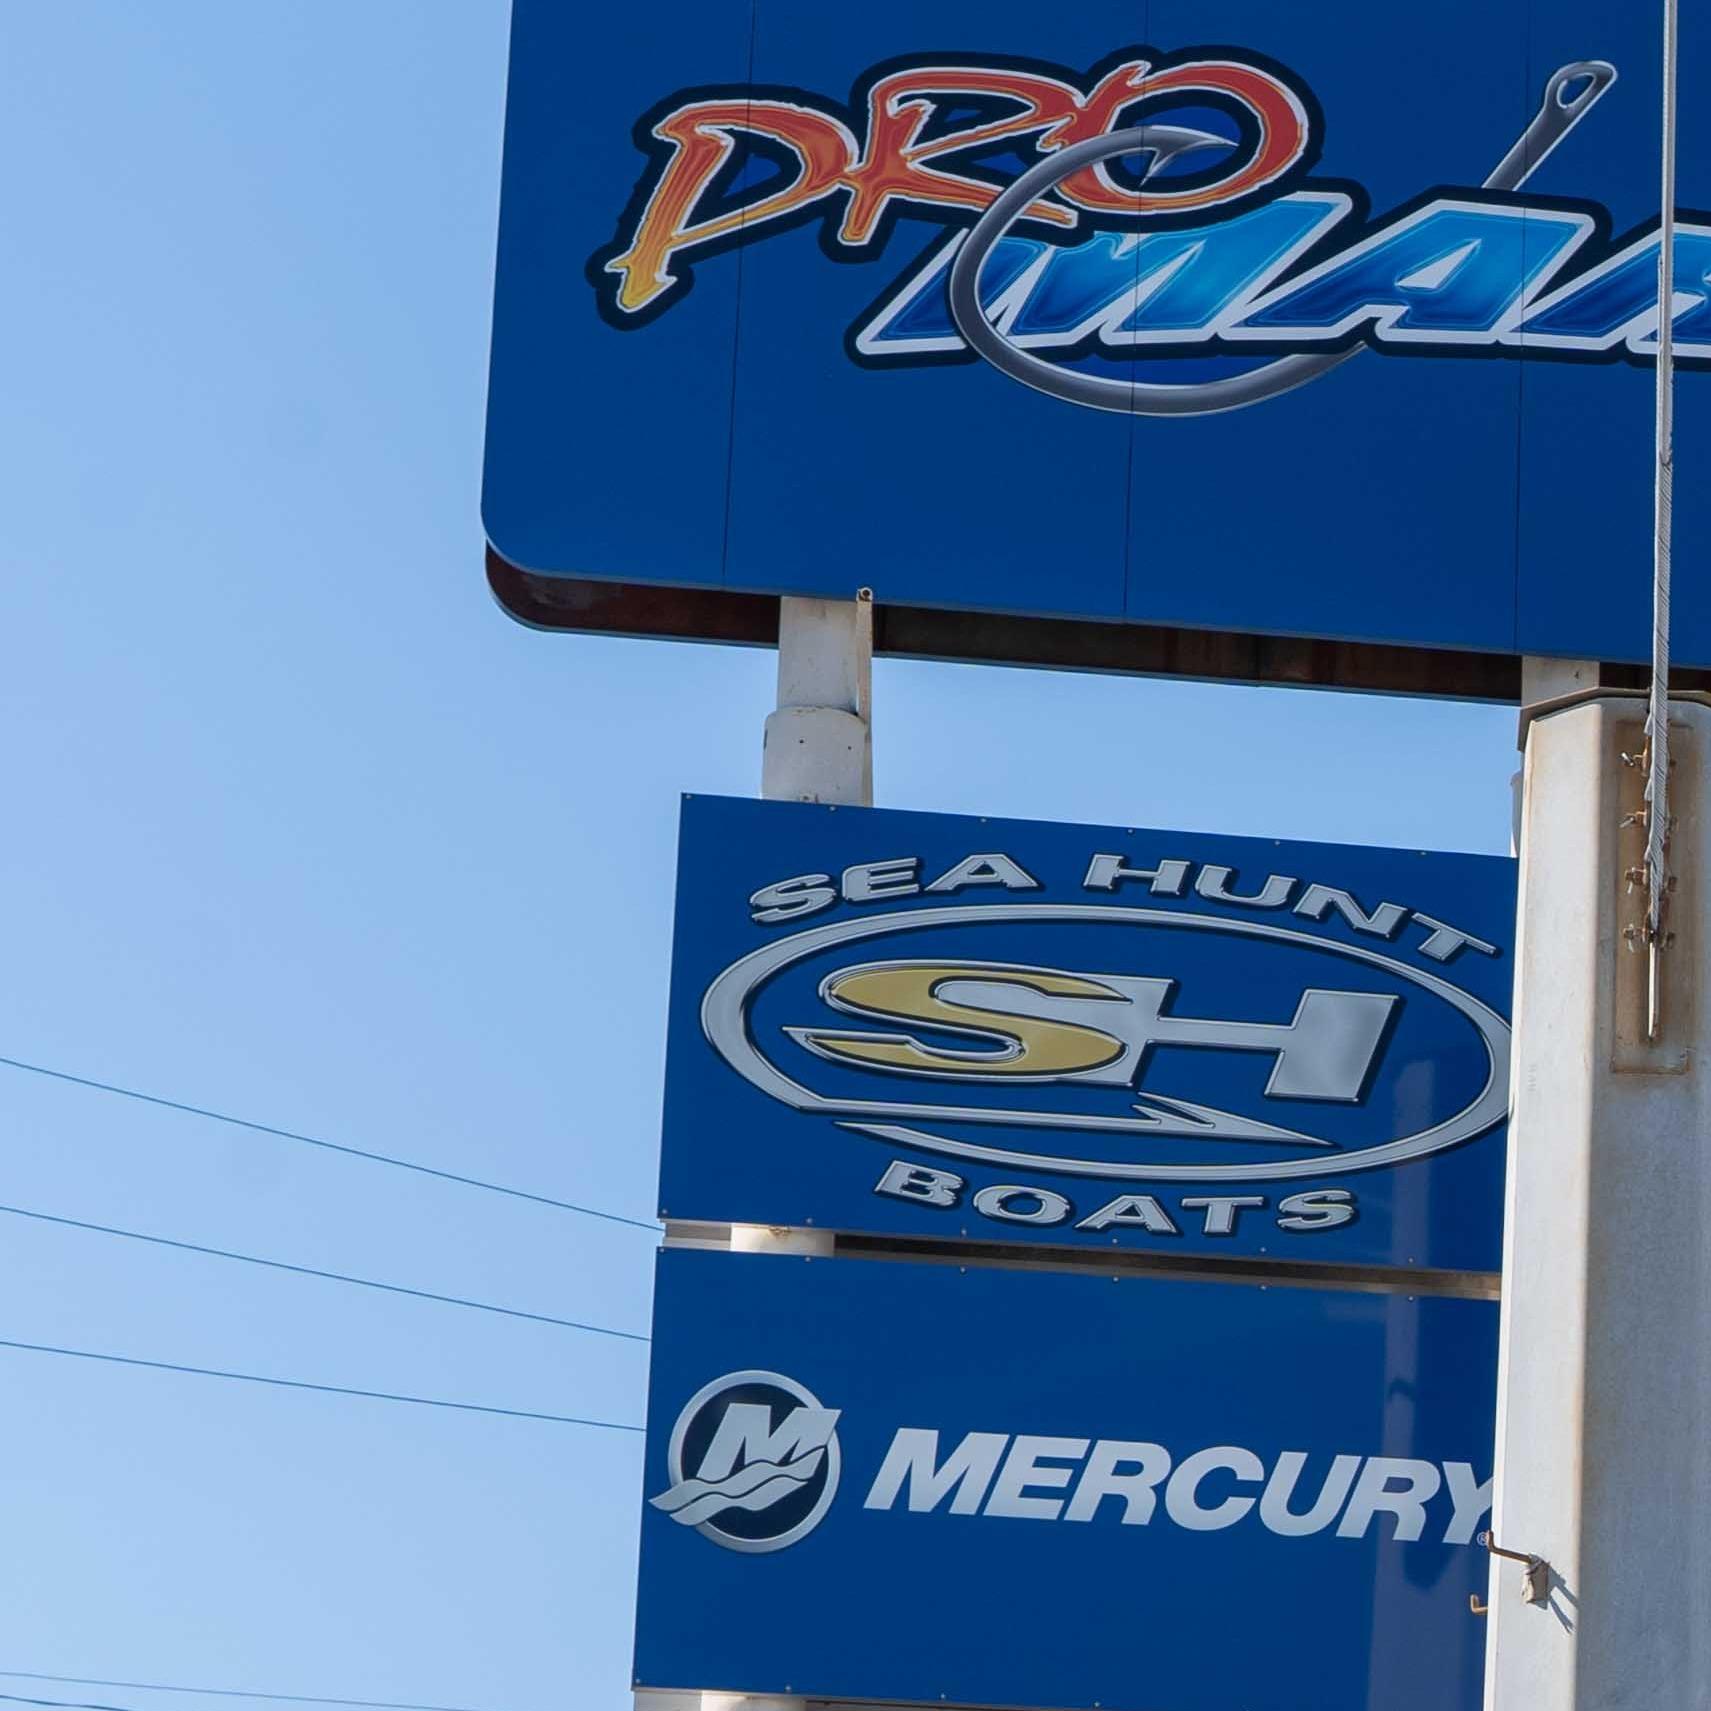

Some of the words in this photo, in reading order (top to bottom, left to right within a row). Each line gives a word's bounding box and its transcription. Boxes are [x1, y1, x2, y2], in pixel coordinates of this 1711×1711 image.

[604, 60, 1308, 312] PRO
[749, 853, 1039, 924] SEA
[1083, 853, 1496, 962] HUNT
[782, 958, 1399, 1102] SH
[875, 1160, 1360, 1234] BOATS
[863, 1428, 1492, 1545] MERCURY
